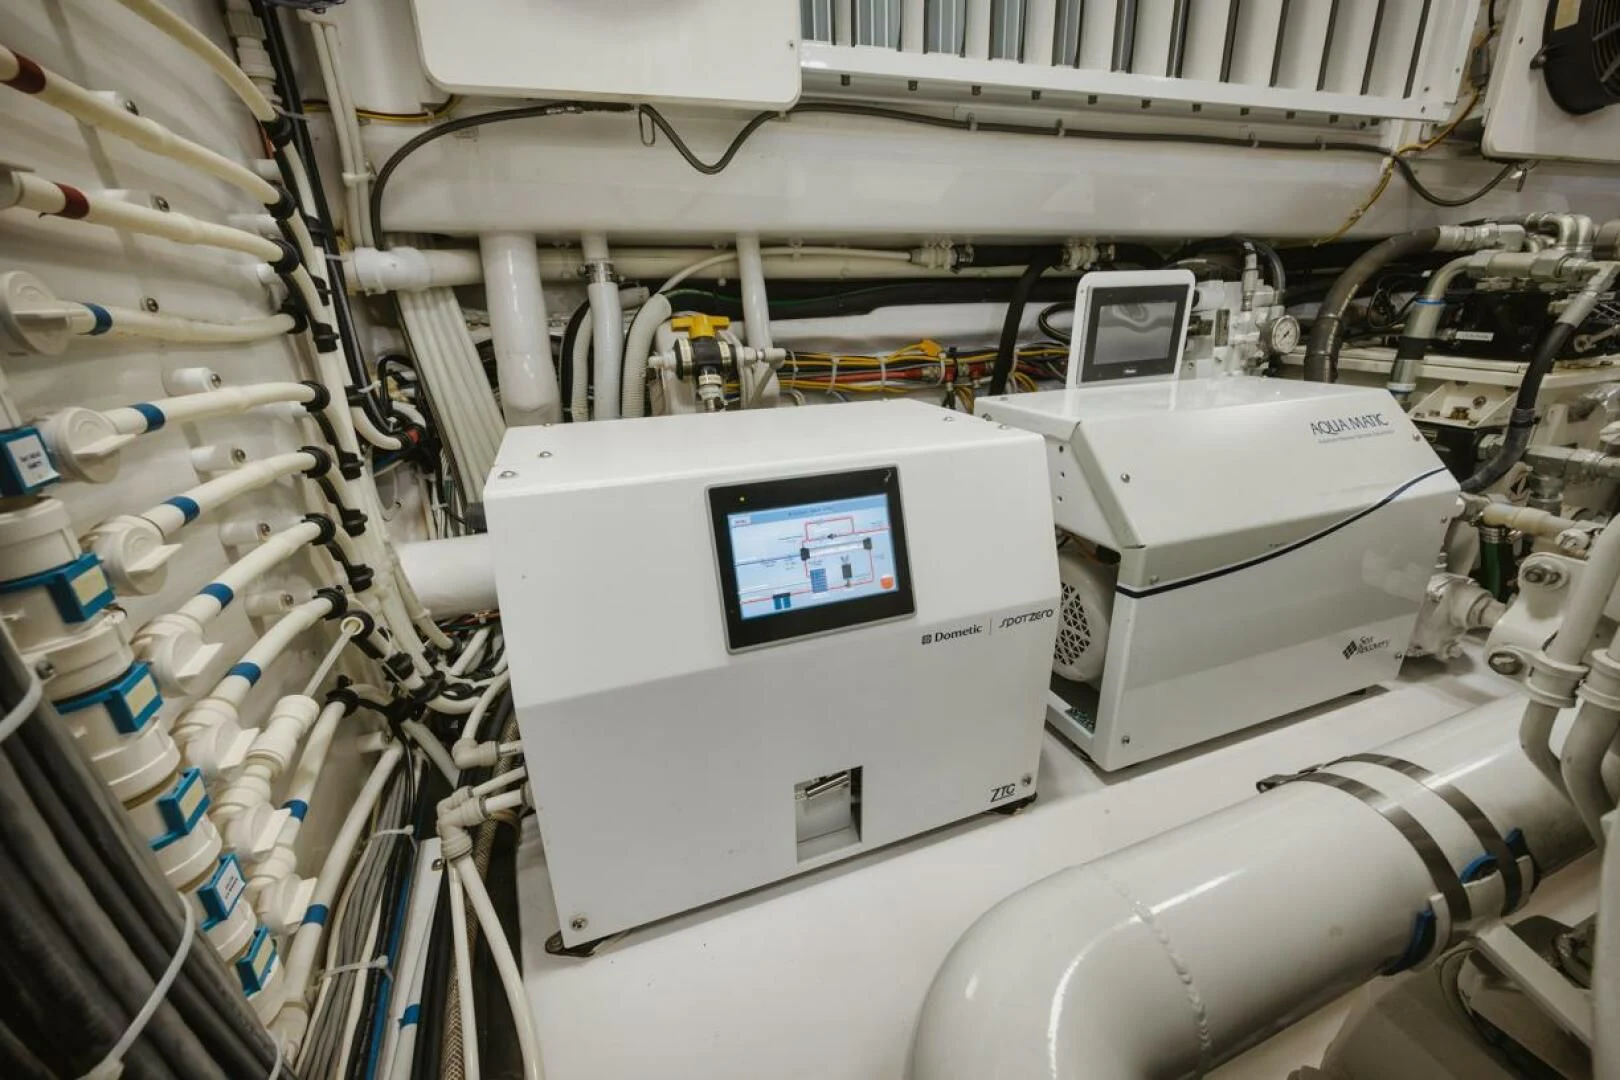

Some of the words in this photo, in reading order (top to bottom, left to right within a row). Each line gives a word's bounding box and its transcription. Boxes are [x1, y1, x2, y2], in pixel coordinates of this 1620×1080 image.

[1310, 418, 1350, 436] AQUA
[1348, 412, 1389, 430] MATIC
[934, 624, 983, 642] Dometic
